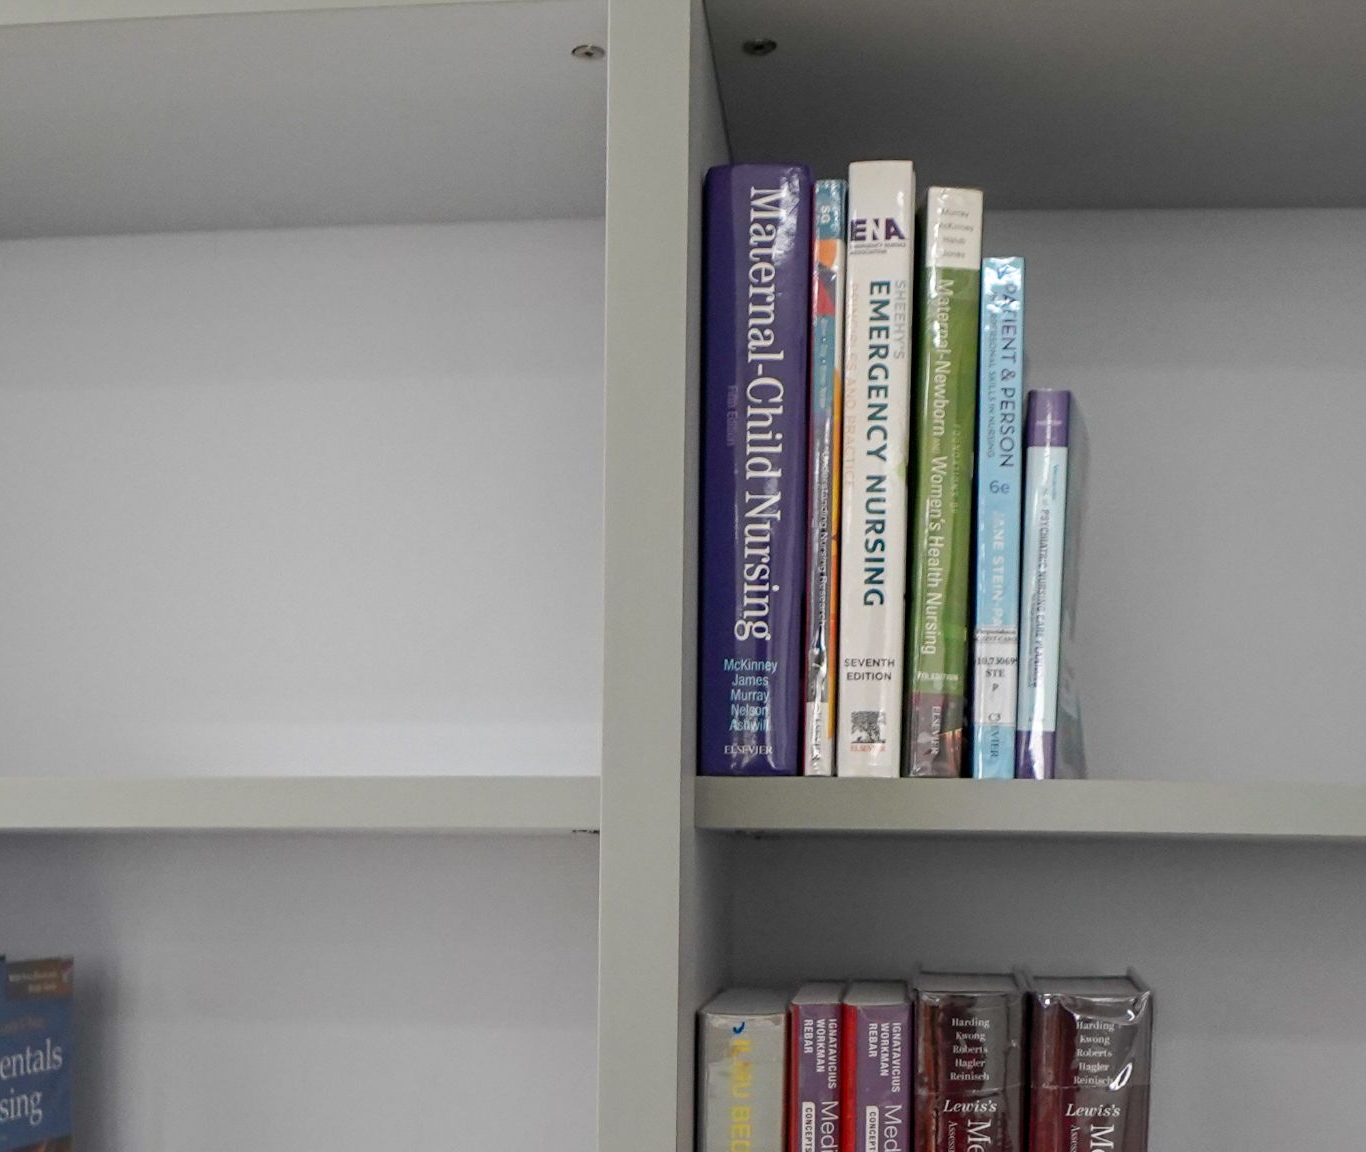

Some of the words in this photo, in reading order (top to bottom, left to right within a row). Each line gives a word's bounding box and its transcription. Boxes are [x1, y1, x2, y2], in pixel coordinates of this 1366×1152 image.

[893, 280, 906, 360] SHEEHY'S
[744, 186, 785, 488] Maternal-Child
[933, 278, 954, 436] Maternal-Newborn
[866, 280, 891, 464] EMERGENCY
[1001, 368, 1016, 381] &
[1000, 389, 1015, 467] PERSON
[926, 455, 948, 532] Women's
[989, 480, 1010, 494] 6e
[863, 474, 886, 607] NURSING
[734, 494, 781, 641] Nursing
[924, 536, 944, 587] Health
[921, 590, 942, 655] Nursing
[724, 658, 777, 672] McKinney
[844, 658, 895, 668] SEVENTH
[732, 674, 769, 687] James
[846, 671, 892, 681] EDITION
[731, 688, 770, 702] Murray
[731, 703, 769, 716] Nelson
[730, 718, 769, 731] Ashwill
[724, 745, 773, 755] ELSEVIER
[952, 1018, 990, 1028] Harding
[804, 1020, 813, 1054] REBAR
[955, 1031, 986, 1041] Kwong
[816, 1019, 825, 1073] WORKMAN
[827, 1019, 837, 1089] IGNATAVICIUS
[955, 1058, 986, 1069] Hagler
[950, 1072, 990, 1081] Reinisch
[943, 1100, 997, 1114] Lewis's
[1066, 1103, 1120, 1117] Lewis's
[805, 1108, 813, 1152] CONCEPTS
